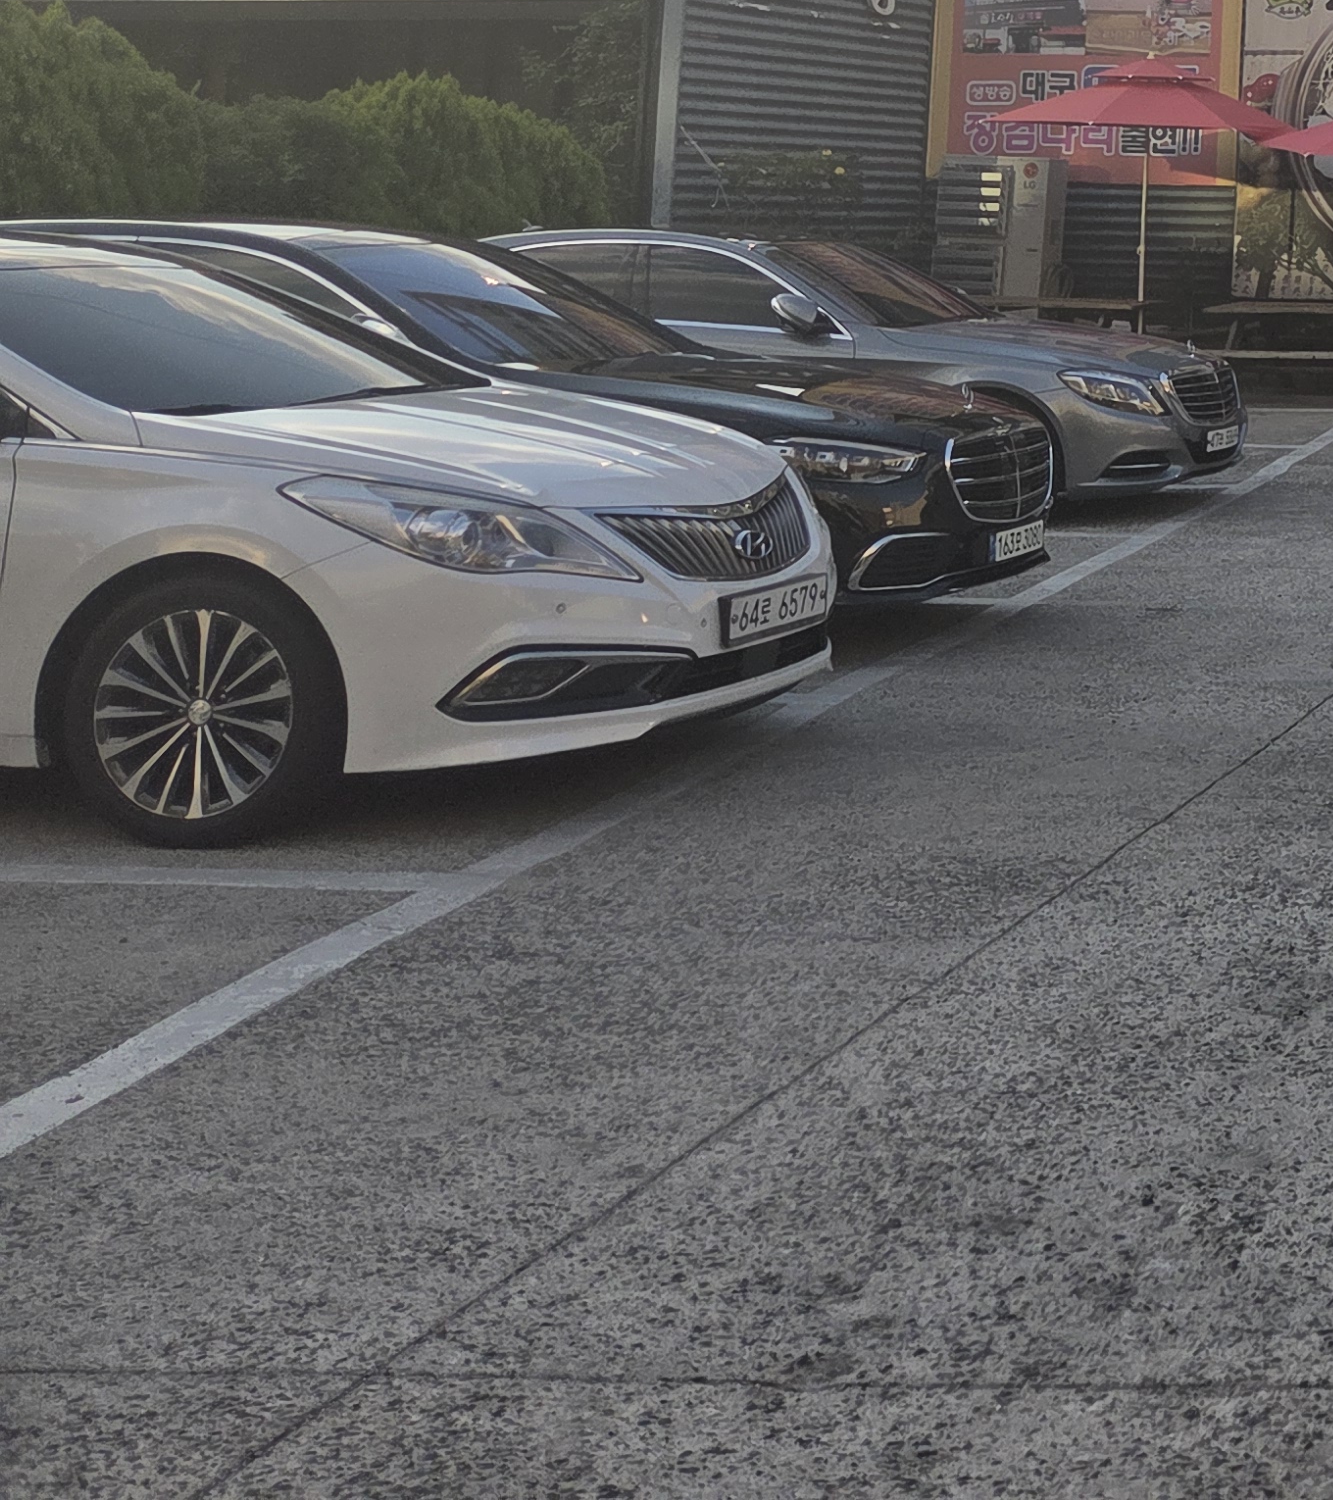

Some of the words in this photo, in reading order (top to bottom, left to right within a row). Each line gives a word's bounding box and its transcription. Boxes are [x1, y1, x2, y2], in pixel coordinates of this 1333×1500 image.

[1023, 180, 1037, 190] LG
[739, 597, 772, 631] 64로
[778, 582, 818, 620] 6579
